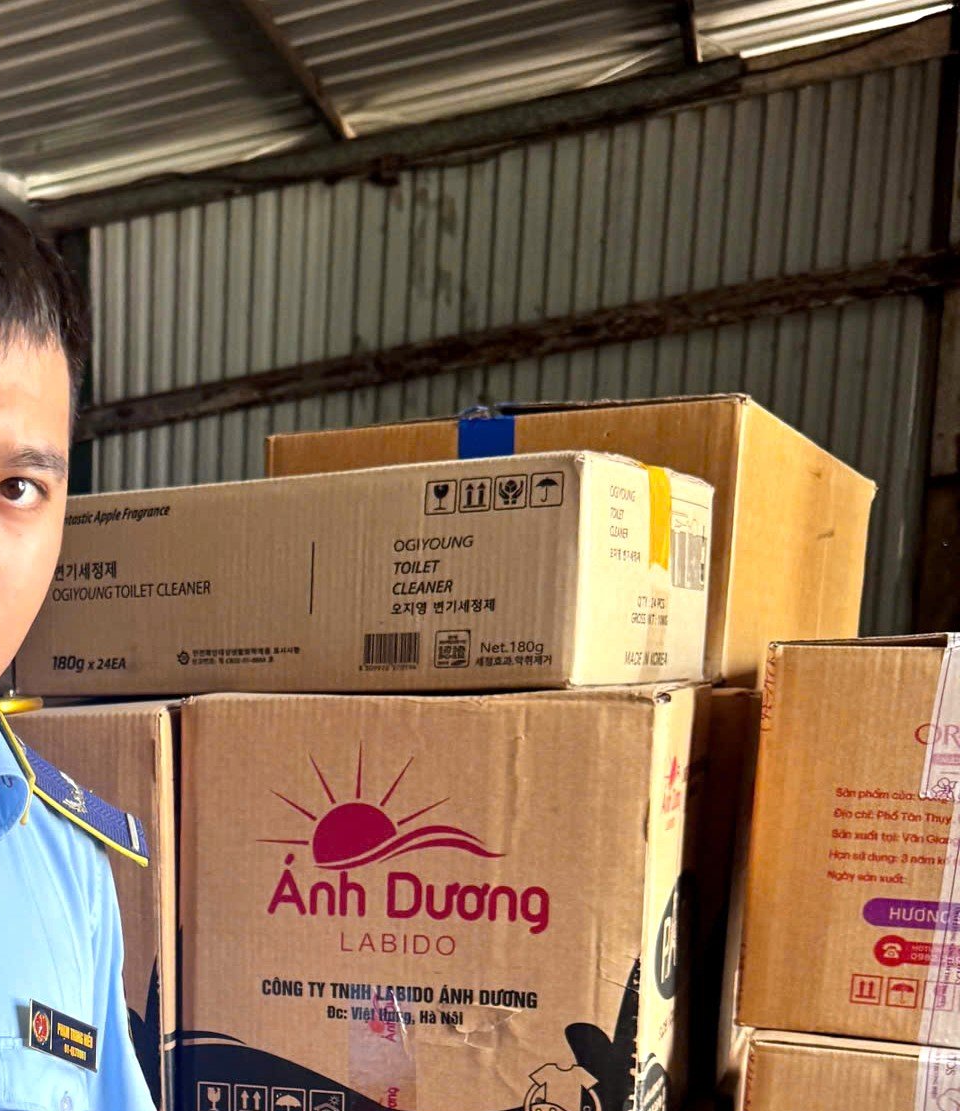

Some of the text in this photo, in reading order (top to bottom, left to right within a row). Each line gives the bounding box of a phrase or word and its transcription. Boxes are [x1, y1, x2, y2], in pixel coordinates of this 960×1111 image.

[64, 505, 171, 526] ntastic Apple Fragrance
[394, 535, 474, 552] OGIYOUNG
[394, 560, 440, 574] TOILET
[52, 580, 211, 602] OGIYOUNG TOILET CLEANER
[392, 579, 453, 595] CLEANER
[52, 656, 84, 673] 180g
[97, 657, 126, 671] 24EA
[267, 853, 550, 934] Ánh Dương
[340, 931, 456, 957] LABIDO
[262, 976, 303, 997] CÔNG
[307, 982, 325, 998] TY
[330, 983, 372, 1000] TNHH
[439, 983, 474, 1005] ÁNH
[479, 988, 538, 1009] DƯƠNG
[327, 1006, 347, 1021] Đc:
[419, 1007, 436, 1024] Hà
